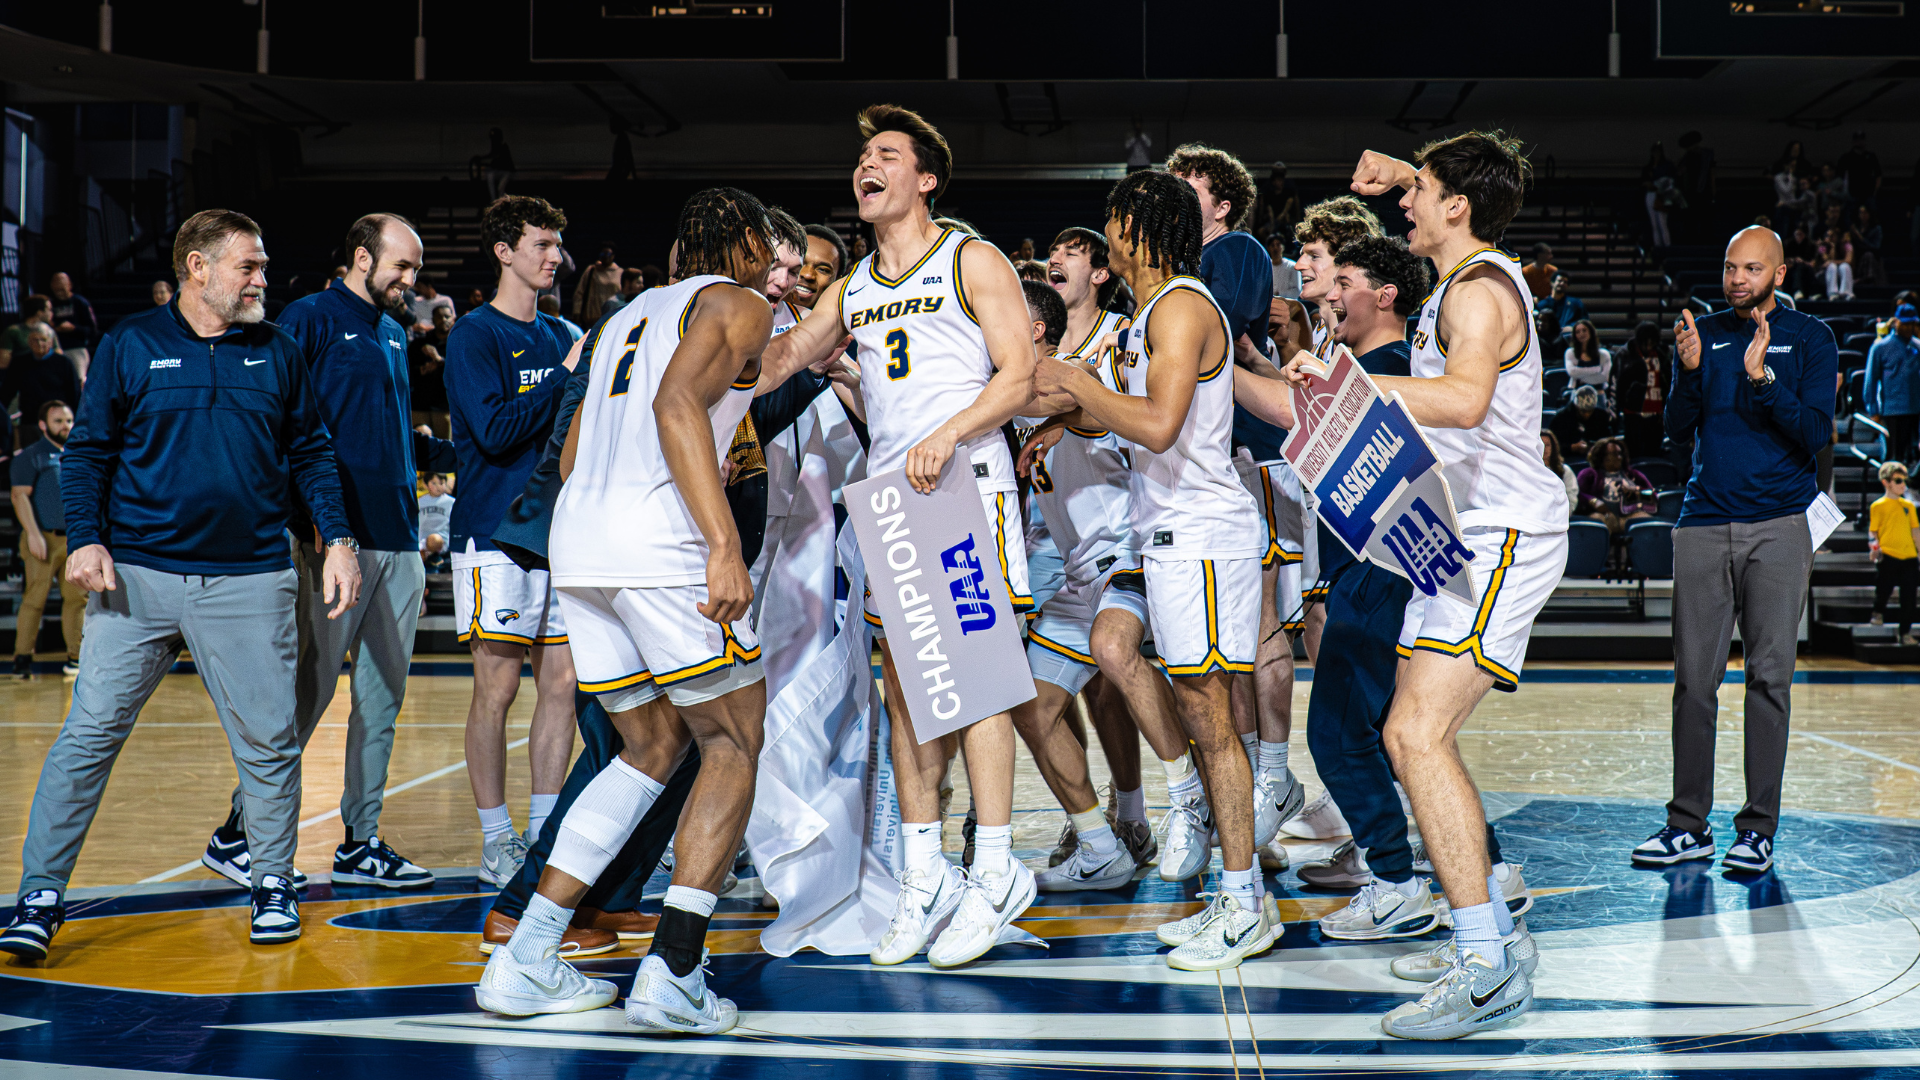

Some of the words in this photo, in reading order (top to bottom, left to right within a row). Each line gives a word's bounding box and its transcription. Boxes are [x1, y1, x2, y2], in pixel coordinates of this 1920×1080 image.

[850, 296, 945, 330] EMORY
[922, 276, 942, 285] UAA
[151, 358, 182, 367] EMORY
[609, 316, 648, 398] 2
[885, 326, 912, 382] 3
[1299, 439, 1331, 484] UNIVERSITY
[1321, 412, 1348, 452] ATHLETIC
[1337, 373, 1372, 426] ASSOCIATION
[1330, 421, 1405, 518] BASKETBALL
[940, 532, 997, 636] UAA
[1381, 496, 1477, 596] UAA
[870, 486, 962, 720] CHAMPIONS
